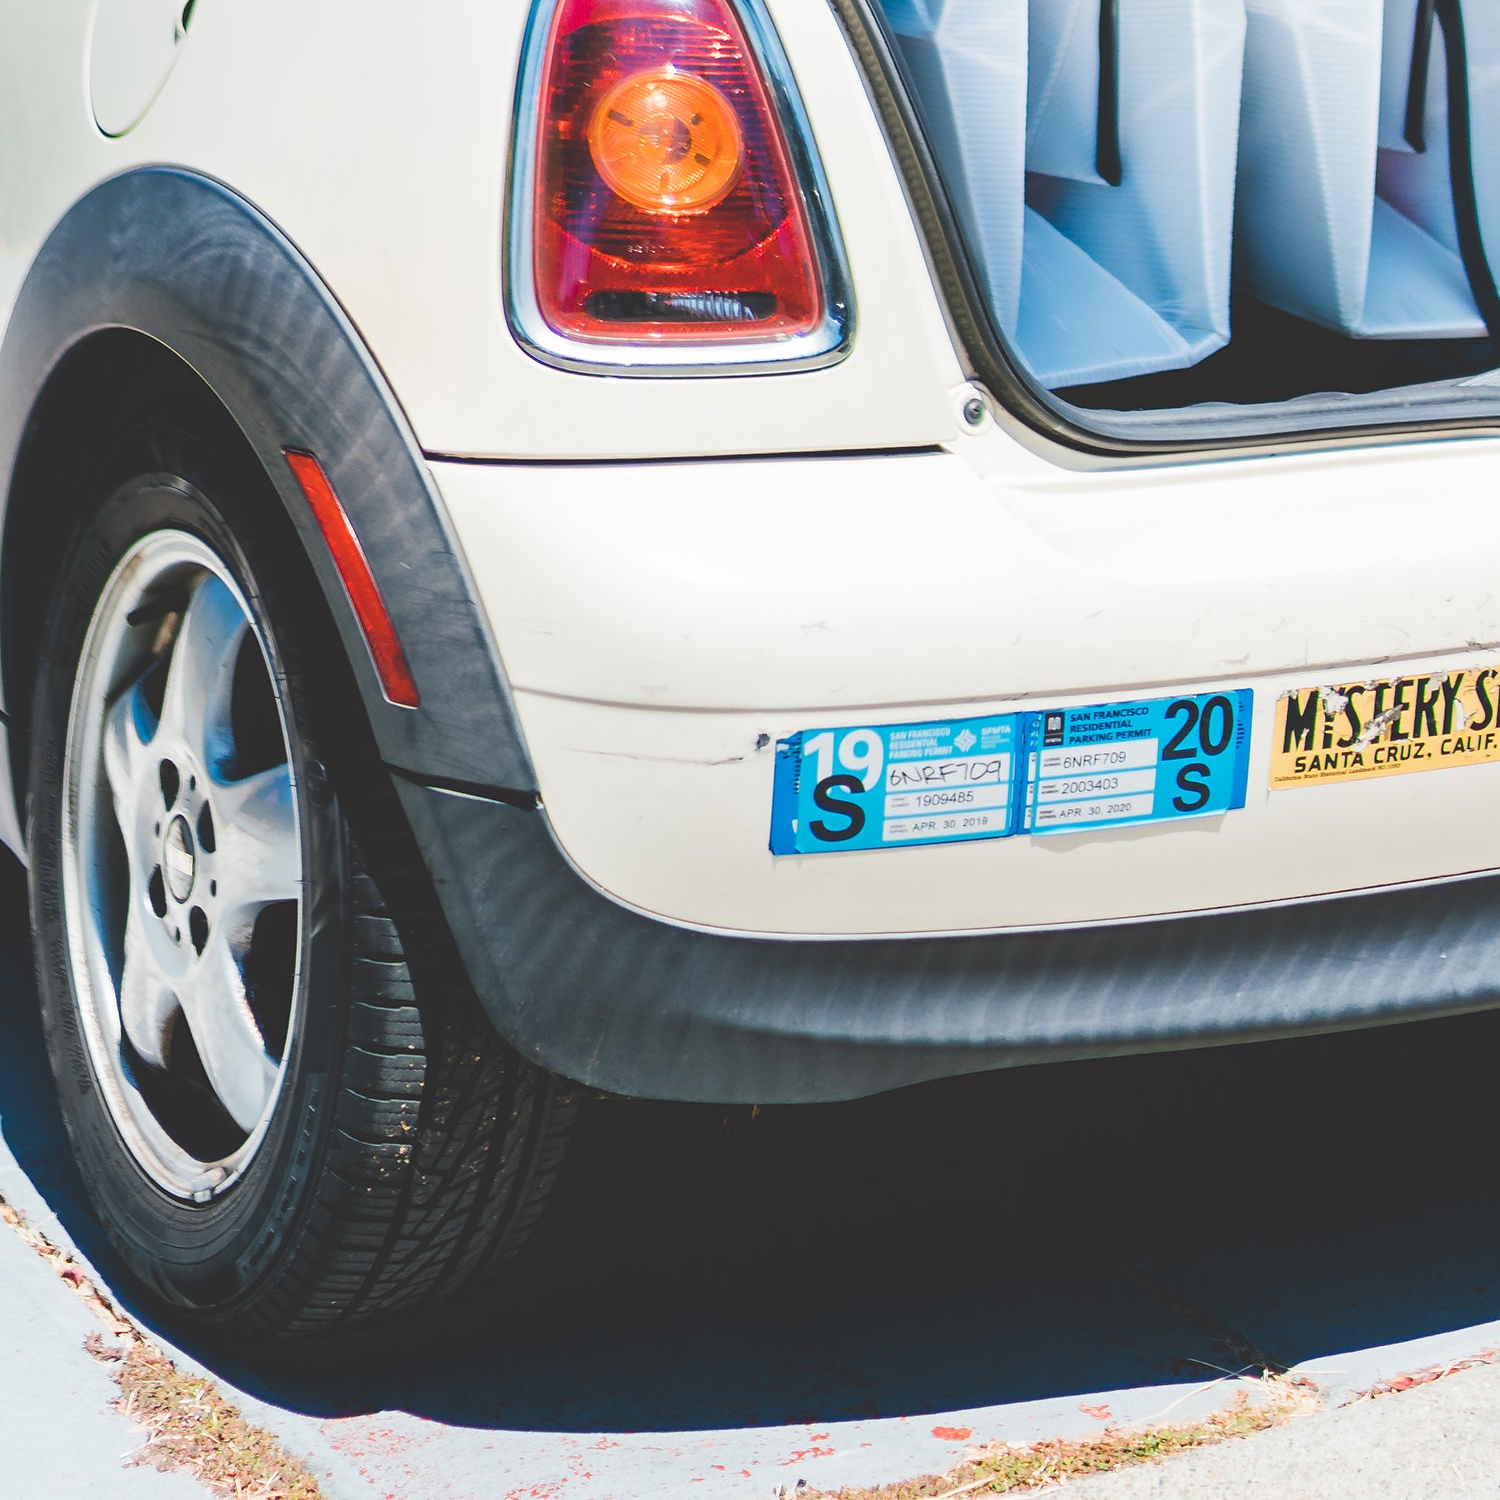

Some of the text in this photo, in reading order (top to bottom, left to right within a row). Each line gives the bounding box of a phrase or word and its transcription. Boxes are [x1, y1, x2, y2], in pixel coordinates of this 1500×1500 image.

[1070, 706, 1149, 722] SAN FRANCISCO
[1069, 720, 1133, 733] RESIDENTIAL
[1162, 695, 1234, 761] 20
[1069, 732, 1113, 744] PARKING
[1115, 728, 1153, 740] PERMIT
[803, 728, 885, 794] 19
[1063, 751, 1127, 769] 6NRF709
[1294, 751, 1364, 774] SANTA
[1440, 733, 1498, 755] CALIF.
[890, 760, 1001, 786] 6NRF709
[1061, 777, 1119, 795] 2003403
[1172, 762, 1212, 812] S
[808, 773, 866, 843] S
[915, 790, 974, 808] 1909485
[1107, 803, 1132, 814] 2020
[963, 816, 989, 828] 2019
